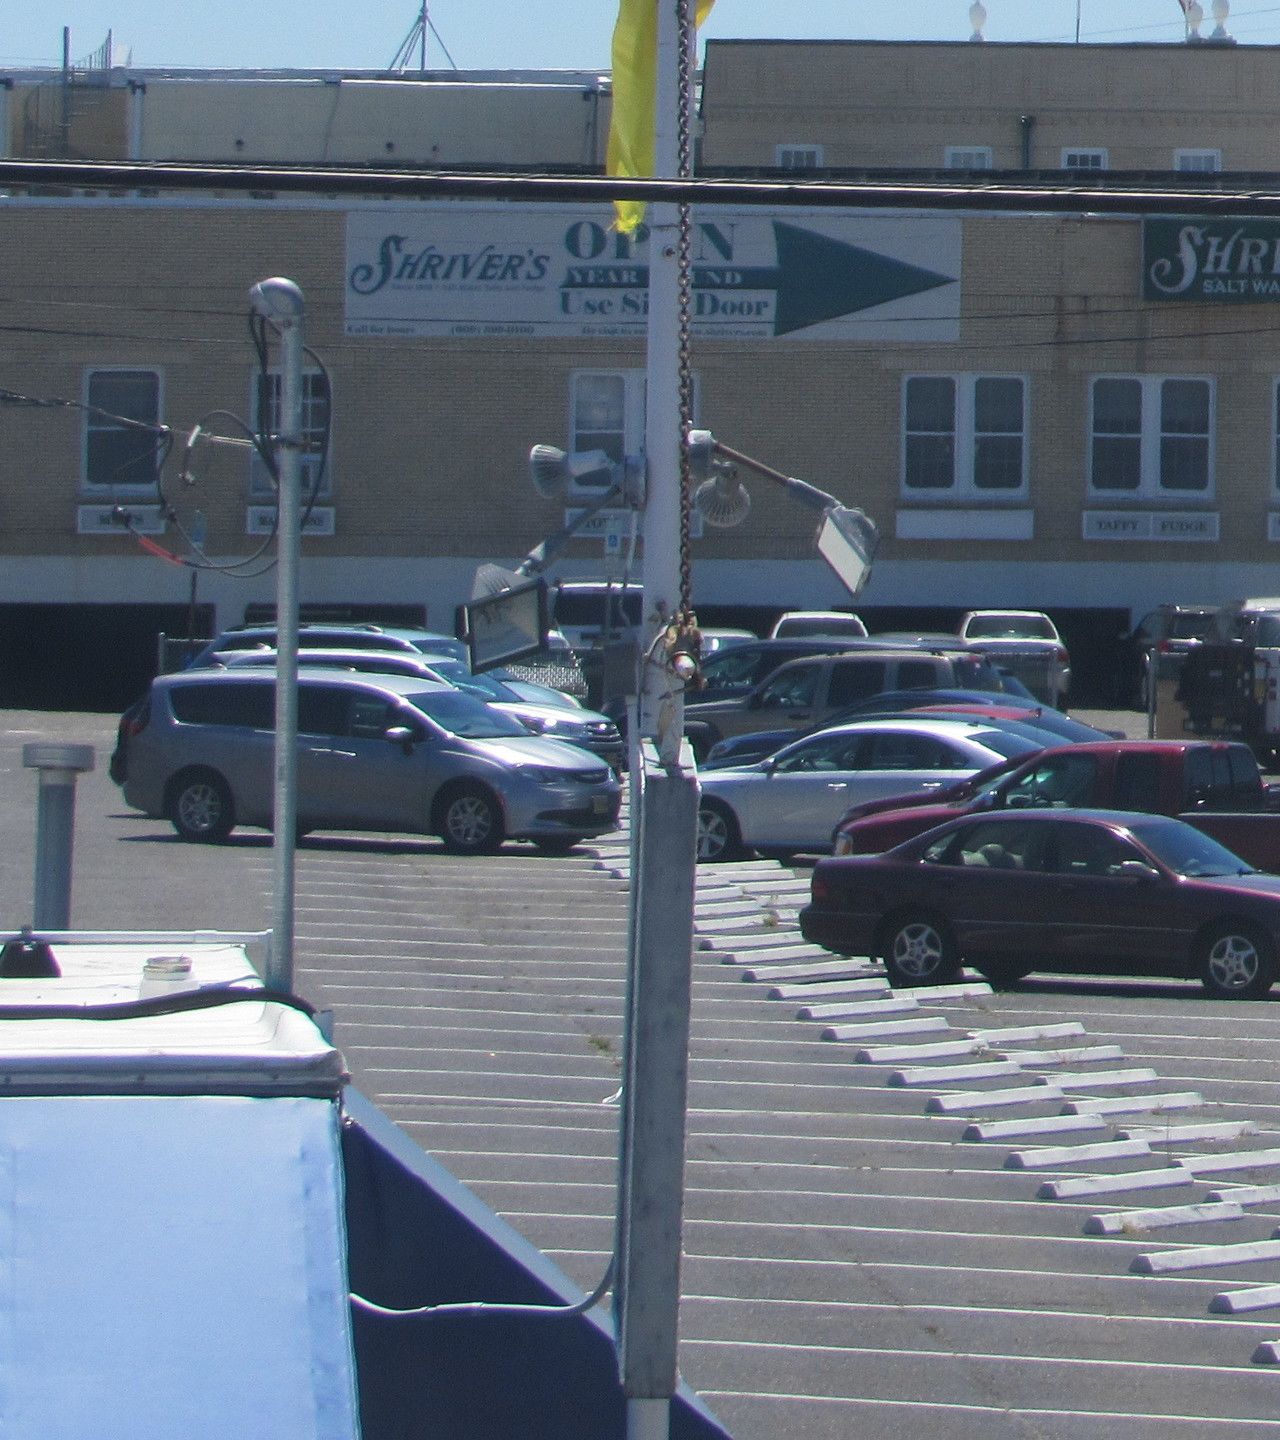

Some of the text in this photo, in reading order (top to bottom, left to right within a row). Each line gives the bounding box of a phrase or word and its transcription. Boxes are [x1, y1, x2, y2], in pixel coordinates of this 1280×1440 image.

[565, 221, 741, 261] OPN
[350, 234, 550, 295] SHRIVER'S
[570, 269, 639, 284] YEAR
[1202, 279, 1249, 294] SALT
[560, 292, 613, 315] Use
[695, 292, 770, 316] Door
[1097, 520, 1139, 531] TAFFY
[1160, 520, 1207, 532] FUDGE
